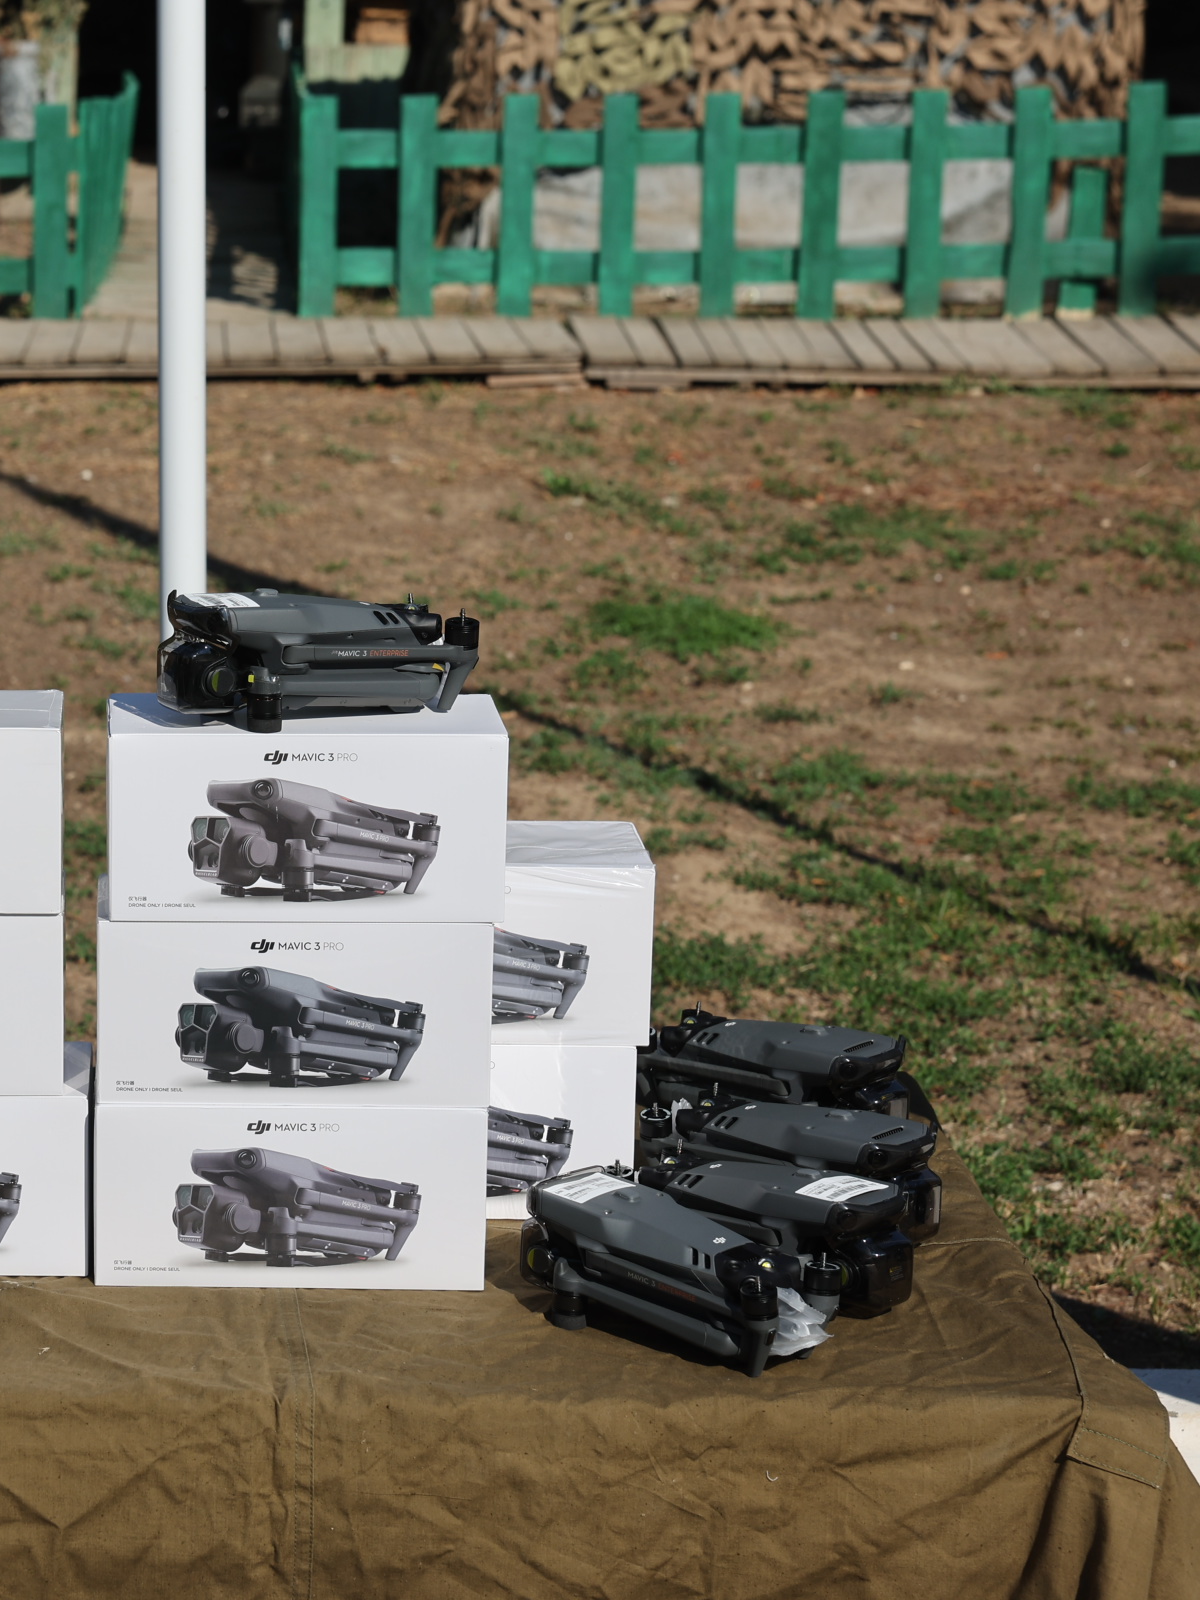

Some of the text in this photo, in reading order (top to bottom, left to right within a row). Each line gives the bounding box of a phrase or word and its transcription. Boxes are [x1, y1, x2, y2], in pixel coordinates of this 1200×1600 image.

[369, 649, 409, 657] ENTERPRISE
[292, 752, 326, 762] MAVIC
[328, 752, 335, 762] 3
[337, 752, 359, 763] PRO
[278, 941, 312, 951] MAVIC
[314, 941, 321, 951] 3
[323, 941, 345, 952] PRO
[275, 1122, 308, 1132] MAVIC
[310, 1122, 317, 1133] 3
[319, 1122, 341, 1133] PRO
[627, 1271, 649, 1285] MAVIC
